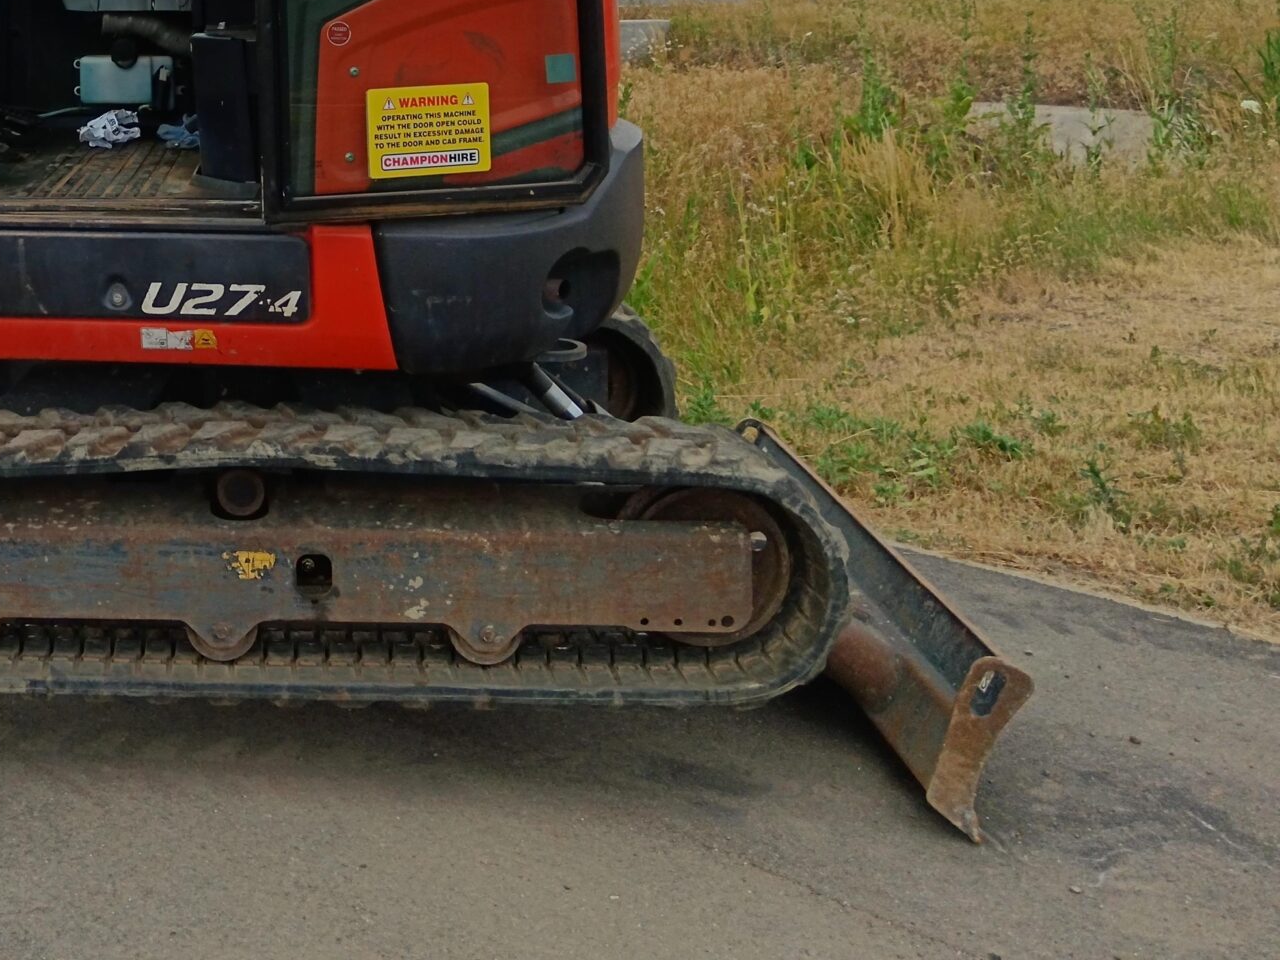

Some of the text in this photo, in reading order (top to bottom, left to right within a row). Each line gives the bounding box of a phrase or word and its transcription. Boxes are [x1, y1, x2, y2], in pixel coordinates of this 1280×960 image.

[398, 95, 459, 108] WARNING
[381, 109, 477, 122] OPERATING THIS MACHINE
[457, 118, 482, 126] COULD
[374, 132, 401, 140] RESULT
[413, 129, 453, 138] EXCESSIVE
[454, 127, 485, 135] DAMAGE
[374, 142, 385, 150] TO
